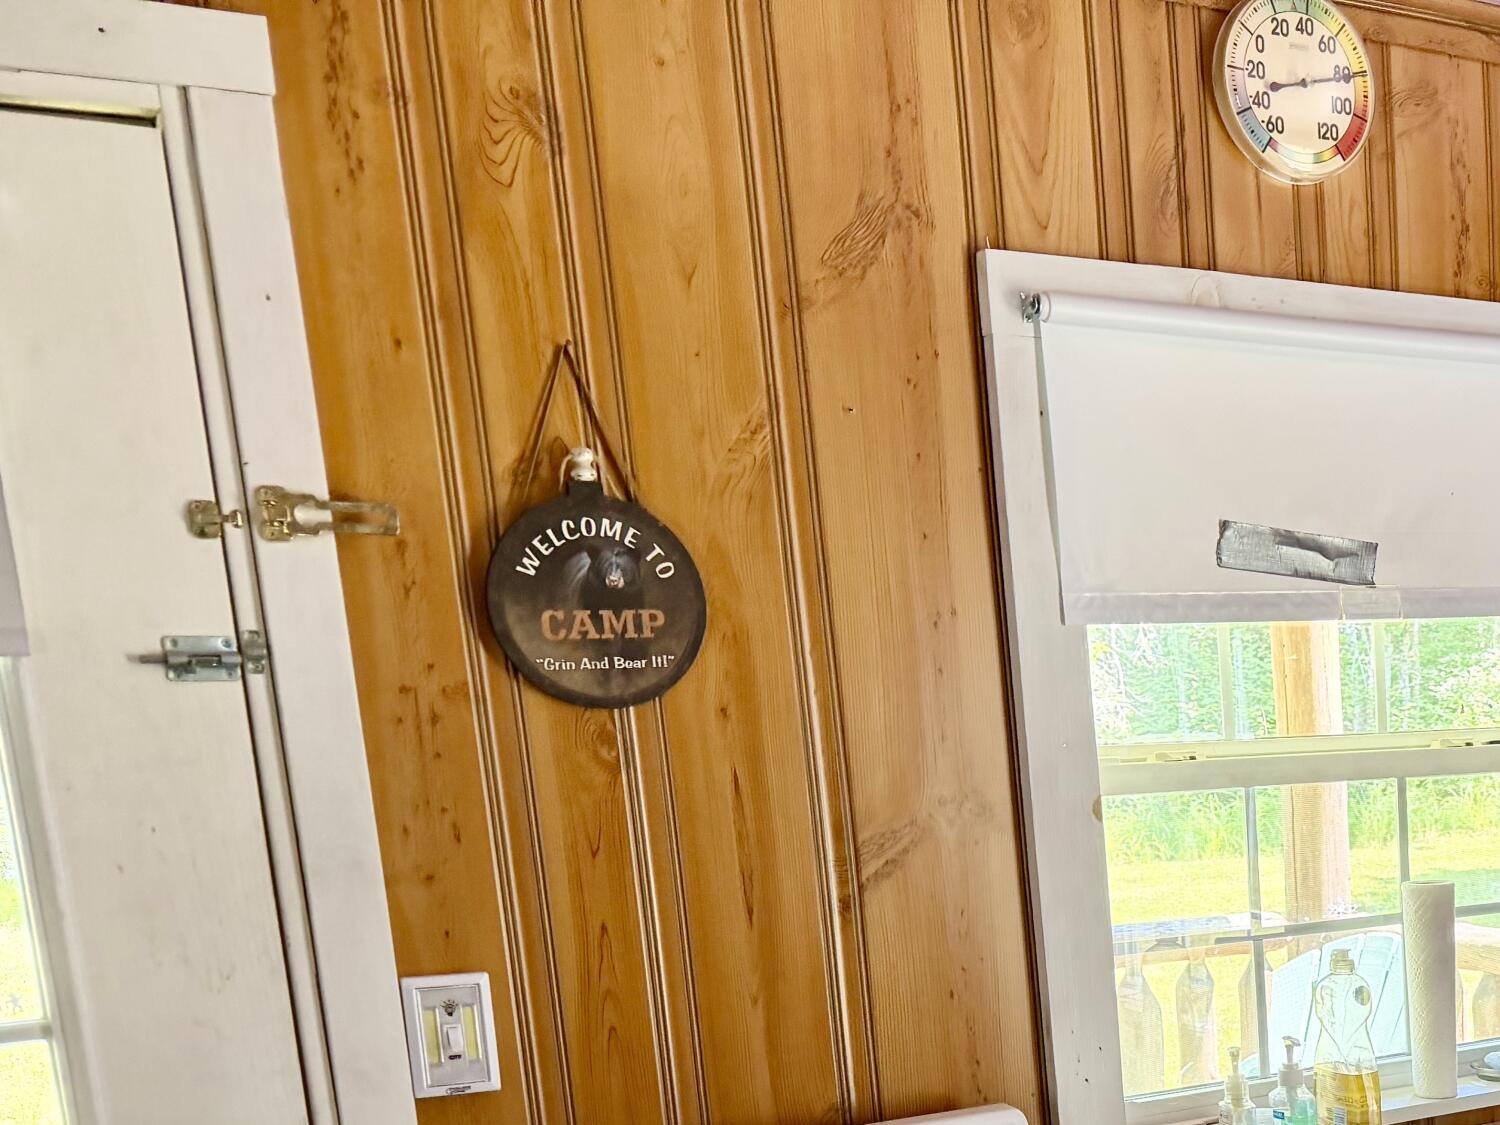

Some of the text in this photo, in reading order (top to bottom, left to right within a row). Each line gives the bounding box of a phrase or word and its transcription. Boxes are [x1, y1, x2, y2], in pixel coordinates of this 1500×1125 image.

[1270, 17, 1289, 37] 20
[1295, 17, 1313, 36] 40
[1255, 34, 1265, 53] 0
[1318, 34, 1336, 54] 60
[1245, 60, 1265, 79] -20
[1333, 65, 1350, 83] 80
[1249, 91, 1270, 109] -40
[1331, 95, 1352, 115] 100
[1261, 115, 1284, 134] -60
[1317, 122, 1339, 141] 120
[515, 516, 675, 579] WELCOME TO
[540, 609, 665, 641] CAMP
[581, 657, 609, 670] And
[614, 656, 648, 669] Bear
